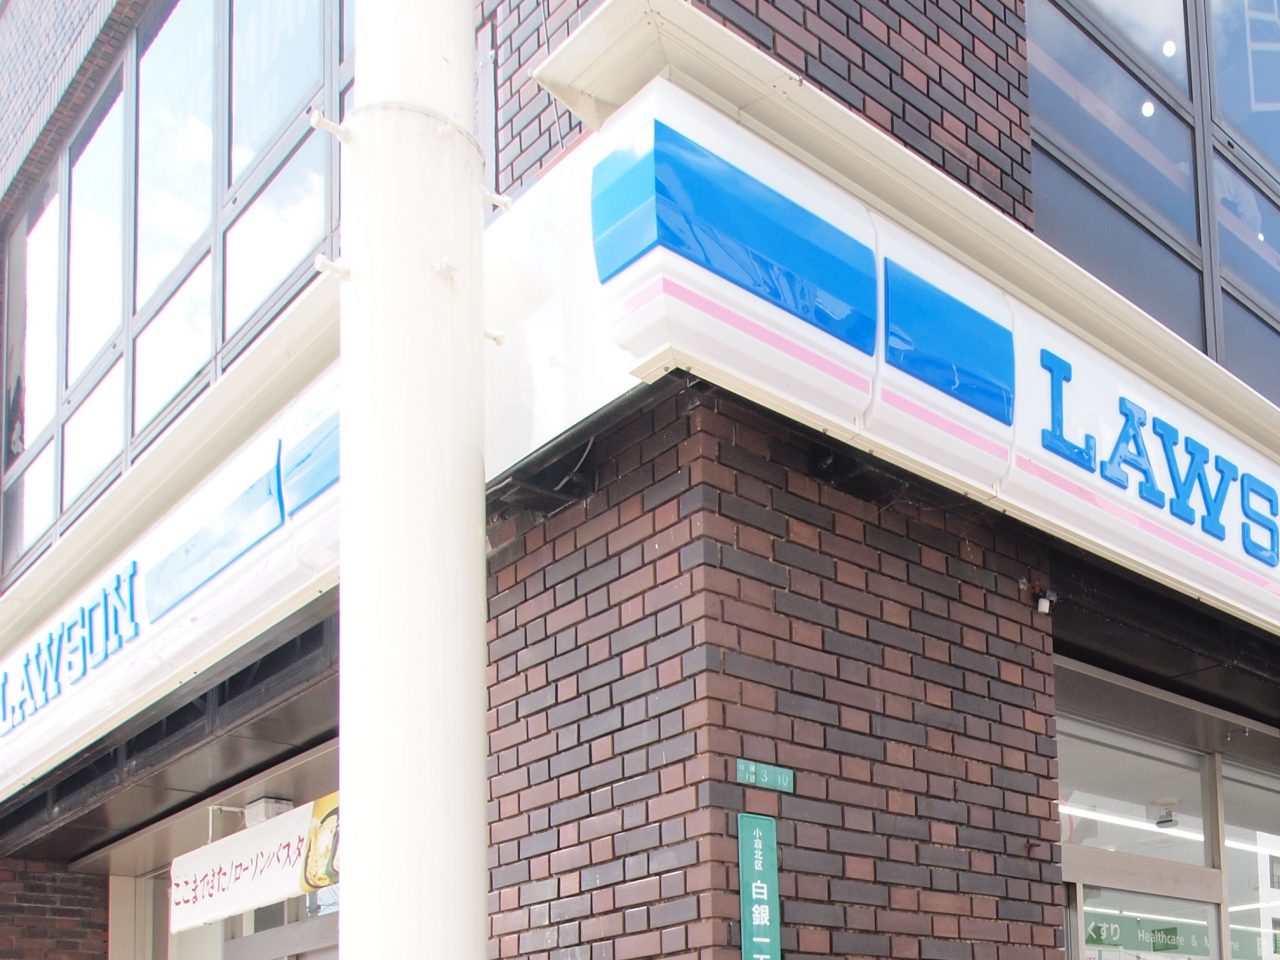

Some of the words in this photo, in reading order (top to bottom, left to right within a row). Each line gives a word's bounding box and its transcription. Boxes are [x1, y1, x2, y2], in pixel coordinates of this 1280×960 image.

[0, 559, 140, 737] LAWSON
[1087, 920, 1120, 942] くすり
[1138, 928, 1185, 948] Healthcare
